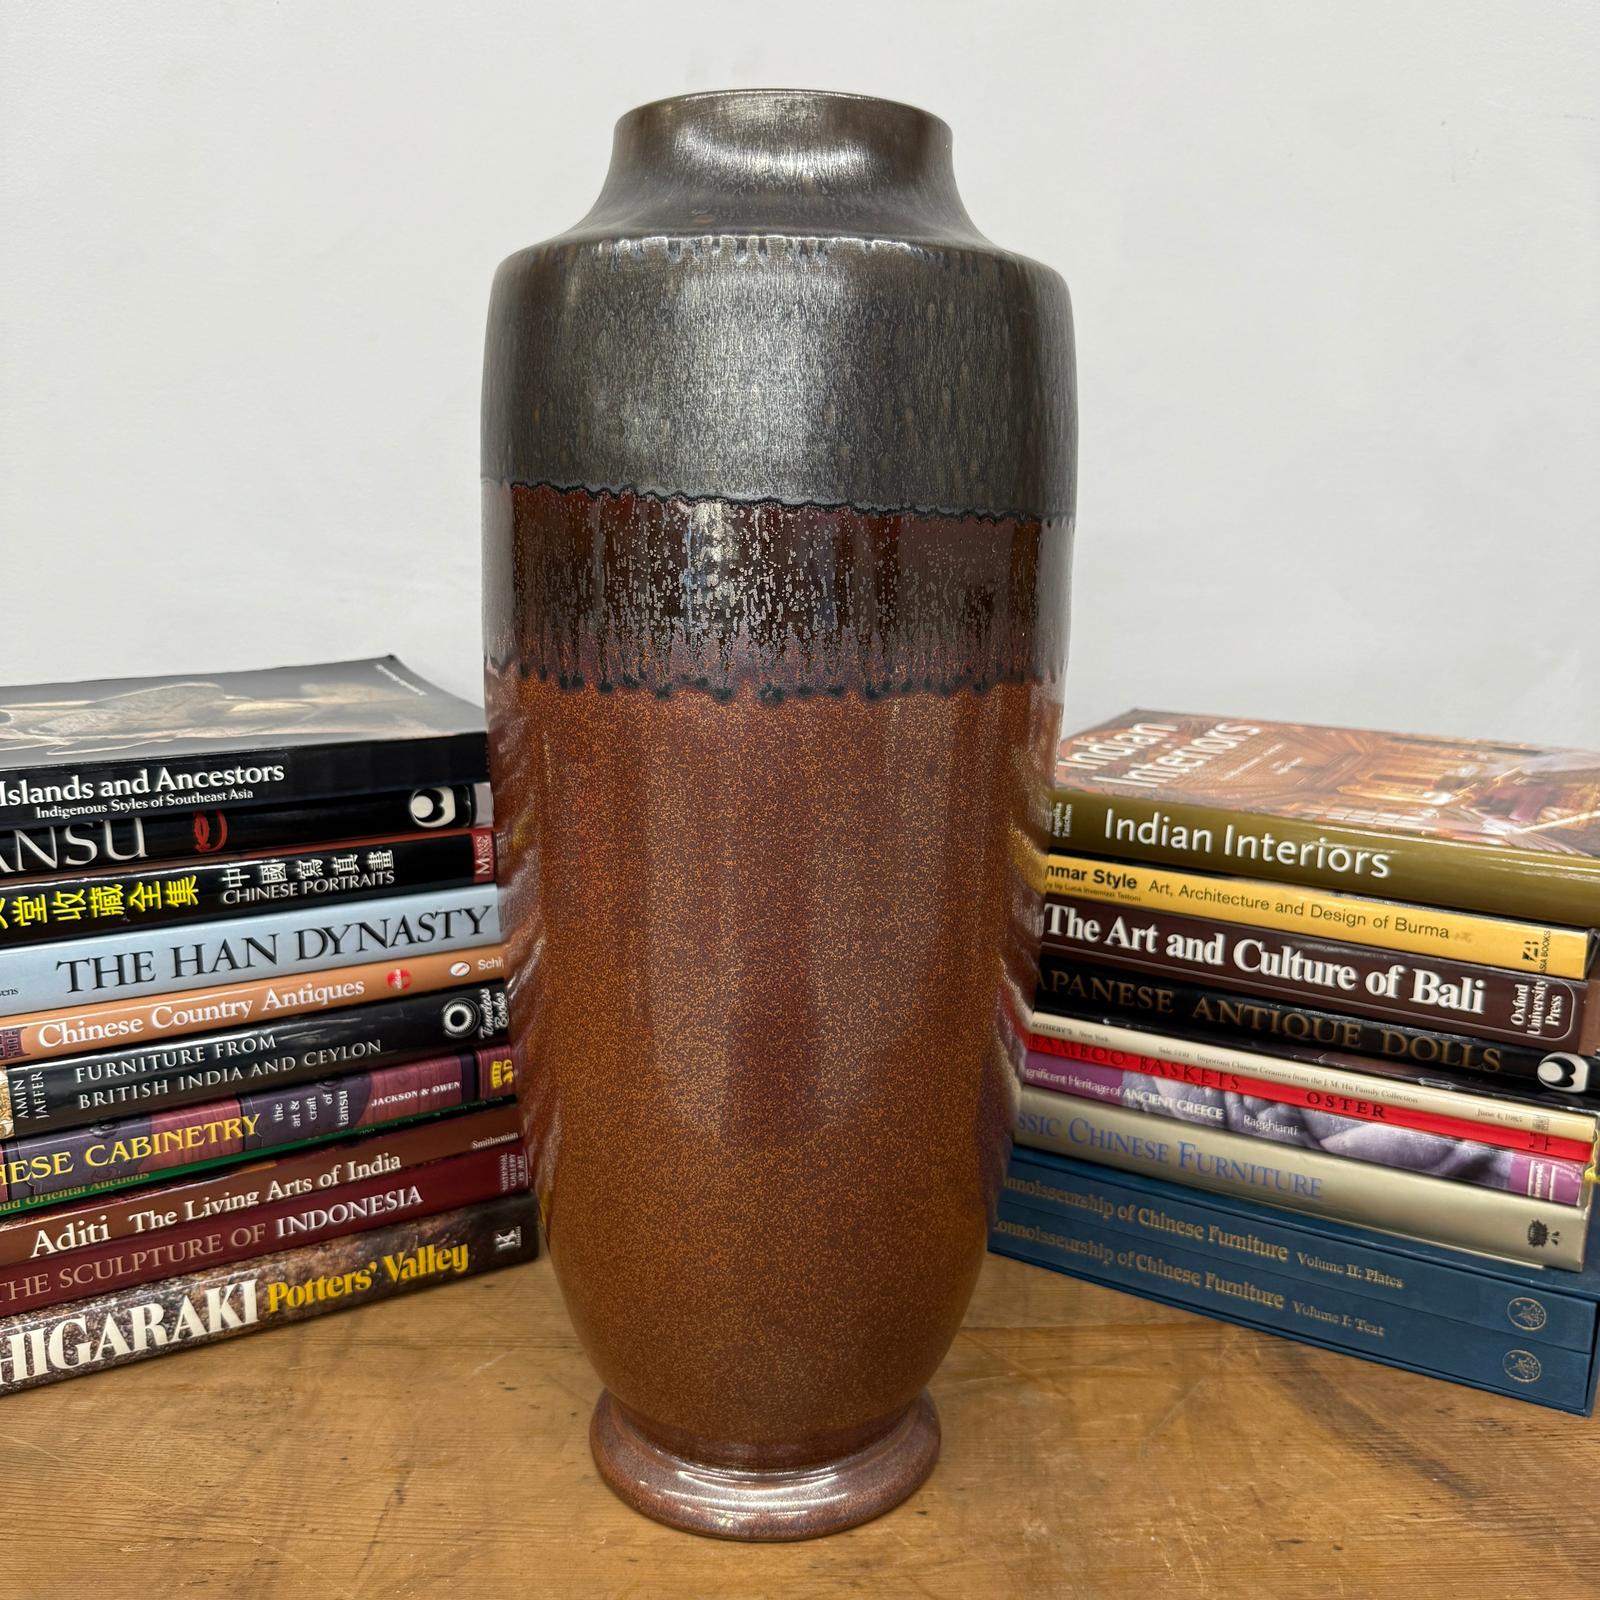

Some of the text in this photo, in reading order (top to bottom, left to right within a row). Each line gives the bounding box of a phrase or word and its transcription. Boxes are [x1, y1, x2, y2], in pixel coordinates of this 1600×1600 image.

[1057, 722, 1180, 770] Indian
[1092, 722, 1261, 788] Interiors
[0, 764, 285, 807] Islands and Ancestors
[36, 788, 253, 819] Indigenous Styles of Southeast Asia
[1105, 808, 1391, 879] Indian Interiors
[223, 870, 395, 904] CHINESE PORTRAITS
[1093, 869, 1137, 889] Style
[1149, 880, 1174, 897] Art,
[1179, 885, 1269, 911] Architecture
[1275, 901, 1304, 916] and
[1310, 903, 1366, 928] Design
[1373, 915, 1389, 929] of
[1395, 917, 1450, 939] Burma
[56, 905, 492, 993] THE HAN DYNASTY
[1044, 903, 1487, 1015] The Art and Culture of Bali
[38, 979, 365, 1049] Chinese Country Antiques
[1510, 984, 1529, 1026] Oxford
[1527, 980, 1549, 1035] University
[1545, 995, 1562, 1026] Press
[1192, 996, 1362, 1048] ANTIQUE
[1382, 1029, 1501, 1073] DOLLS
[76, 1034, 277, 1083] FURNITURE FROM
[79, 1039, 382, 1110] BRITISH INDIA AND CEYLON
[1139, 1052, 1240, 1090] BASKETS
[13, 1079, 29, 1119] AMIN
[31, 1071, 49, 1119] JAFFER
[274, 1103, 284, 1121] the
[307, 1096, 318, 1121] craft
[325, 1093, 333, 1104] of
[338, 1090, 349, 1127] tansu
[370, 1081, 461, 1108] JACKSON & OWEN
[1068, 1075, 1110, 1095] Heritage
[1110, 1085, 1122, 1097] of
[1123, 1088, 1175, 1110] ANCIENT
[1177, 1098, 1225, 1121] GREECE
[1306, 1091, 1386, 1118] OSTER
[85, 1113, 260, 1167] CABINETRY
[292, 1113, 301, 1128] art
[471, 1131, 519, 1149] Smithsonian
[1243, 1113, 1299, 1137] Ragghianti
[1068, 1117, 1169, 1164] CHINESE
[1178, 1140, 1323, 1200] FURNITURE
[30, 1152, 401, 1258] Aditi The Living Arts of India
[58, 1233, 224, 1289] SCULPTURE
[231, 1223, 266, 1248] OF
[276, 1185, 424, 1238] INDONESIA
[1117, 1204, 1136, 1221] of
[1138, 1208, 1203, 1240] Chinese
[1208, 1225, 1288, 1261] Furniture
[1296, 1252, 1343, 1276] Volume
[1364, 1268, 1404, 1290] Plates
[383, 1243, 469, 1282] Valley
[1117, 1251, 1136, 1267] of
[1136, 1254, 1202, 1287] Chinese
[1205, 1272, 1285, 1310] Furniture
[1292, 1301, 1340, 1324] Volume
[1354, 1318, 1386, 1338] Text
